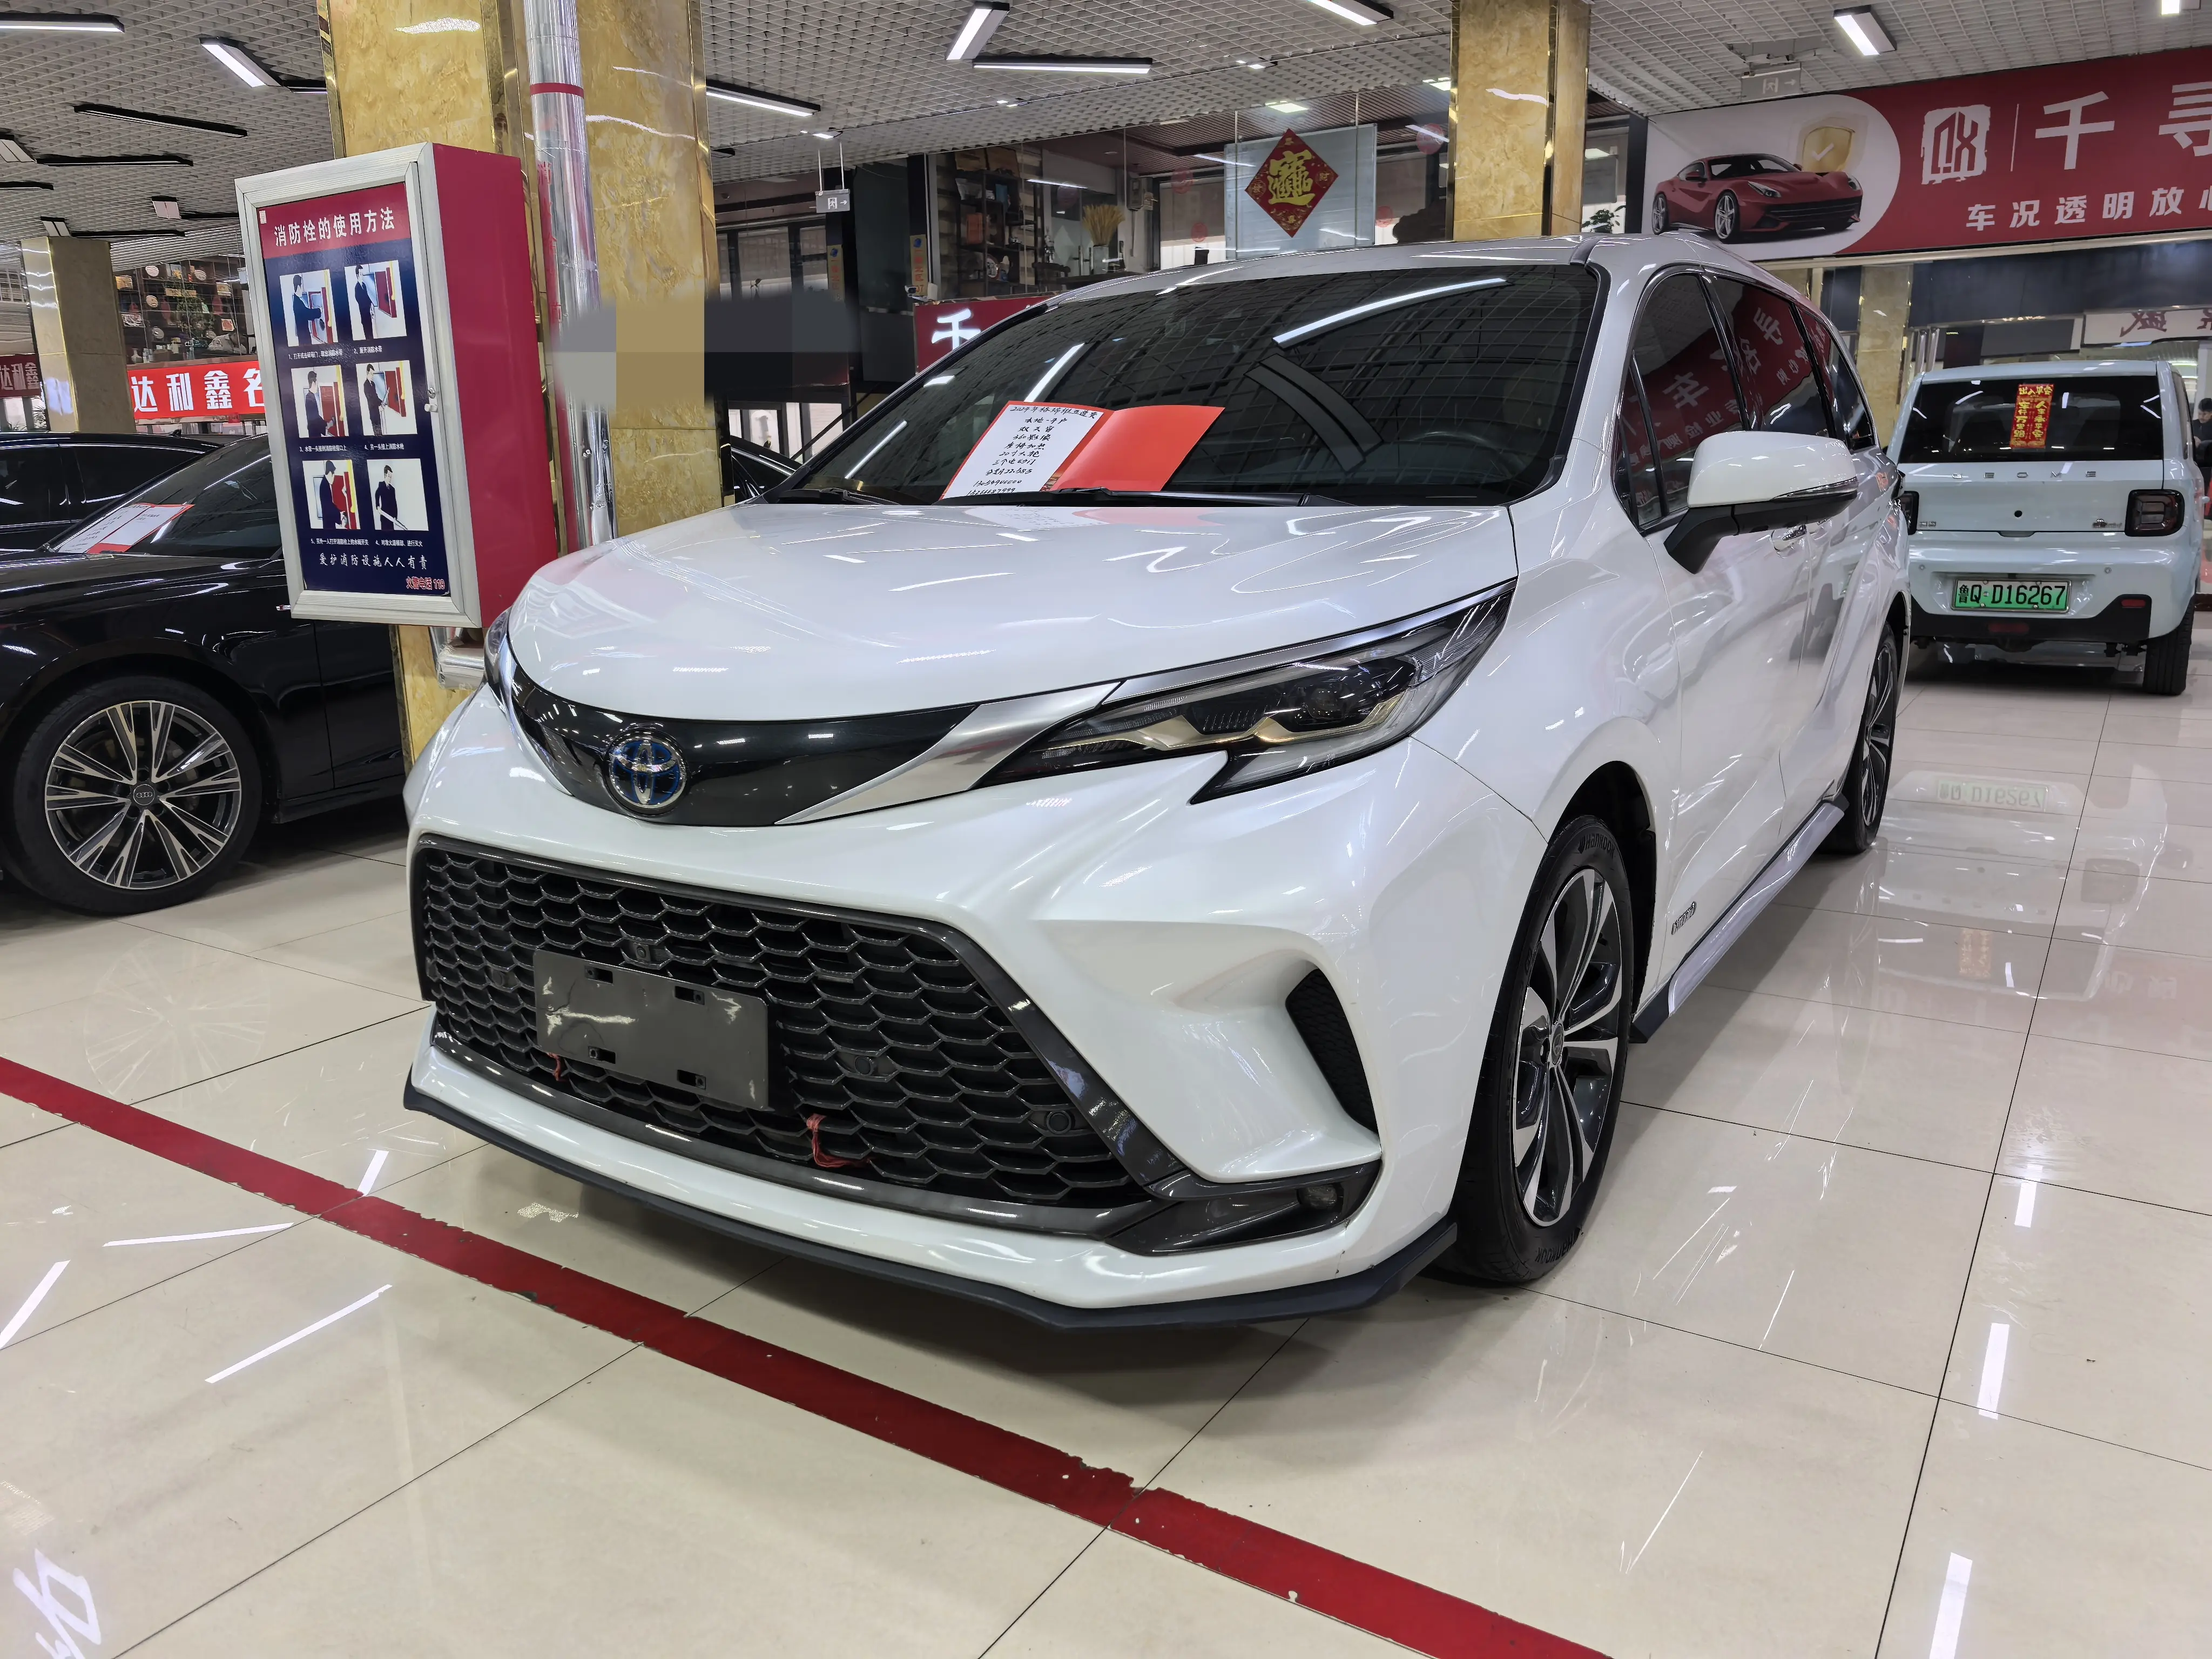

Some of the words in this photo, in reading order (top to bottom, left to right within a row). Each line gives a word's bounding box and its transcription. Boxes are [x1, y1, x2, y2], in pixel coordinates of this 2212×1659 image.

[274, 207, 395, 247] 消防栓的使用方法
[131, 368, 265, 413] 达利鑫名
[1951, 470, 2096, 479] GEOME
